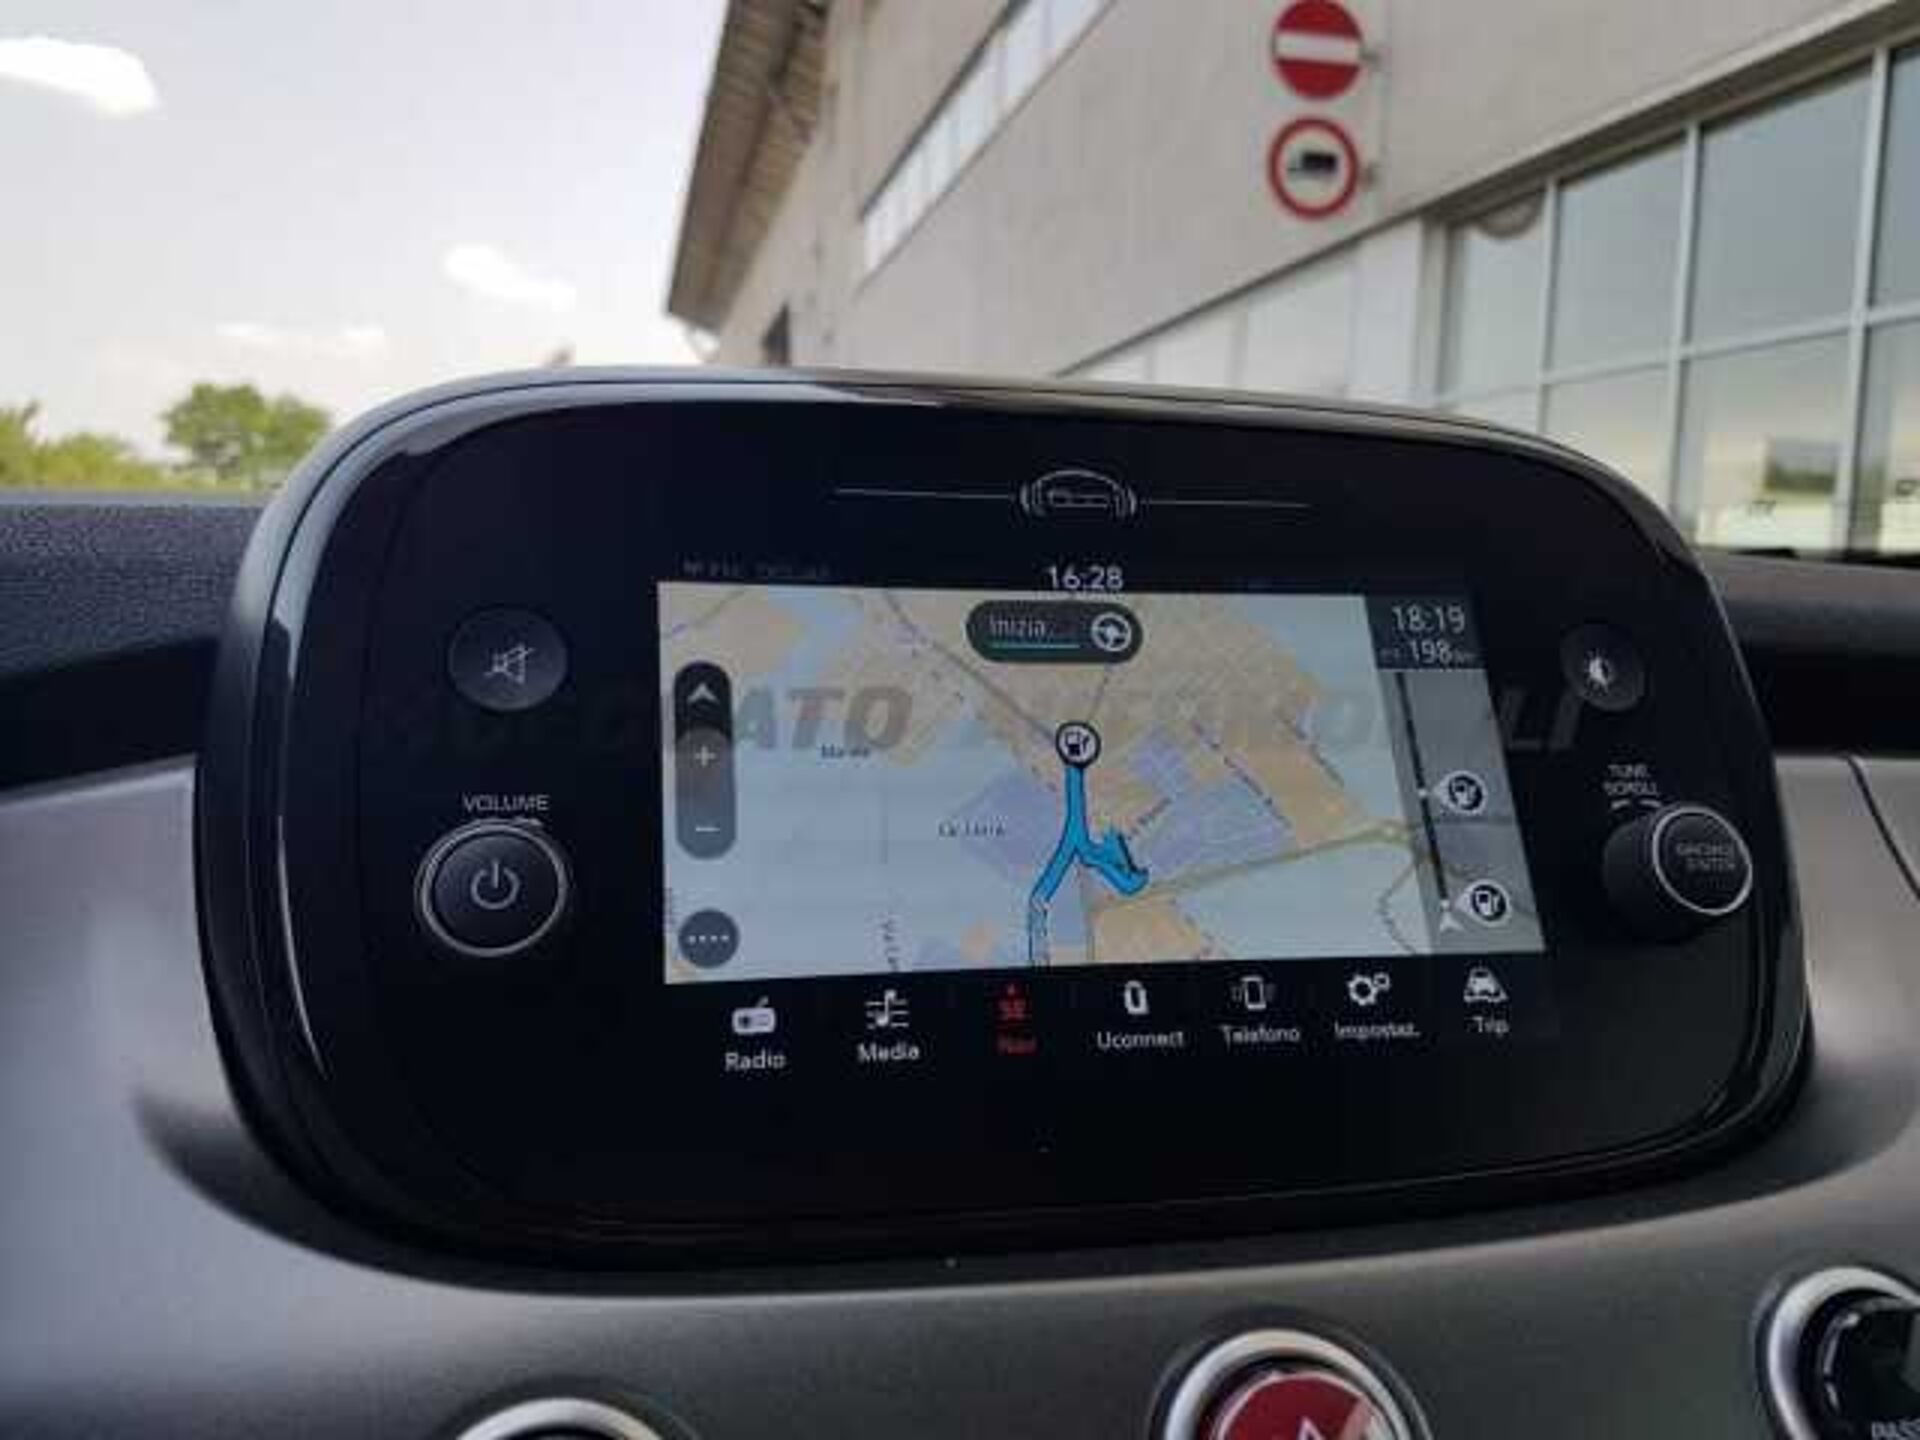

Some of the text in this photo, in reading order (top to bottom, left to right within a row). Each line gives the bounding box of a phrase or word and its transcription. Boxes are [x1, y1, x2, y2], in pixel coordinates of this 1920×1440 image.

[1048, 565, 1124, 590] 16:28
[1392, 605, 1466, 634] 18:19
[1409, 638, 1453, 665] 198
[462, 794, 550, 812] VOLUME
[1097, 1030, 1184, 1050] Uconnect
[1221, 1025, 1300, 1047] Telefono
[725, 1051, 786, 1072] Radio
[858, 1042, 920, 1062] Media
